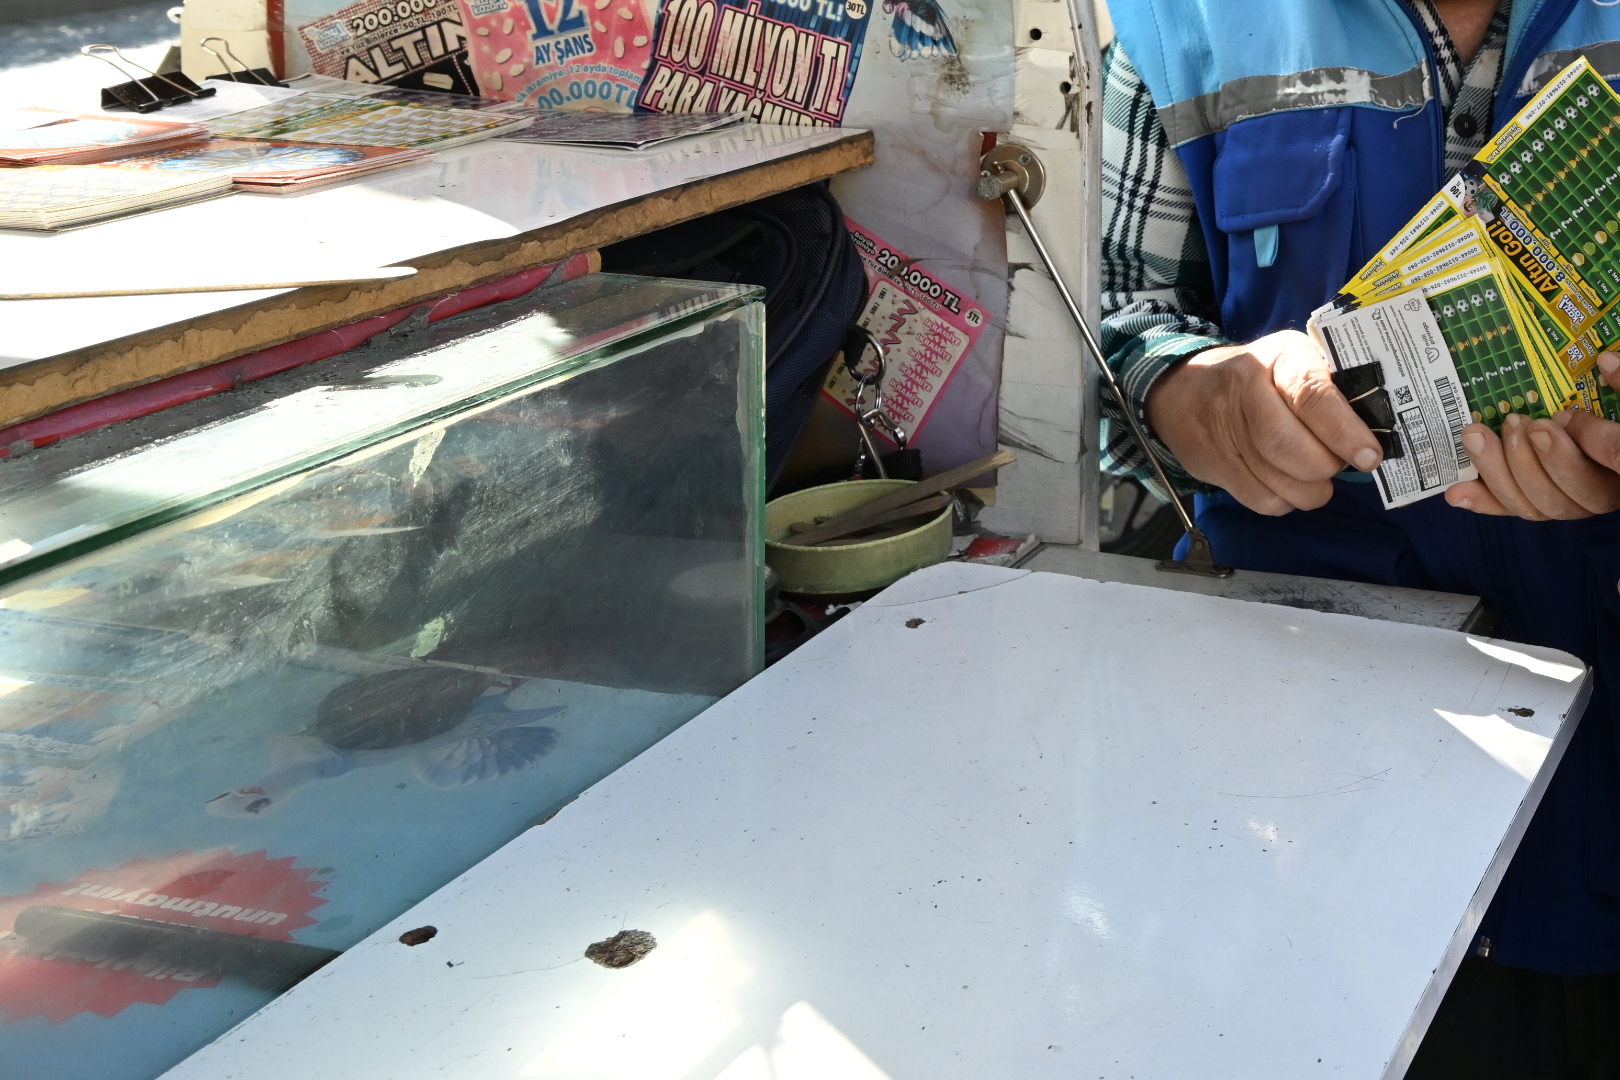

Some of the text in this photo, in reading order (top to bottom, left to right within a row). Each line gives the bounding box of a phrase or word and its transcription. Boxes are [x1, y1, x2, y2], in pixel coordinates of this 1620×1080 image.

[846, 1, 866, 15] 30TL
[367, 27, 397, 43] Binlerce
[403, 21, 413, 29] 50
[432, 9, 445, 17] 100
[535, 34, 594, 66] AY ŞANS
[710, 3, 816, 104] MİLYON
[815, 36, 848, 117] TL
[569, 65, 581, 74] 12
[583, 64, 607, 75] ayda
[609, 66, 643, 85] toplam
[643, 65, 714, 112] PARA
[1451, 186, 1461, 197] 100
[1499, 207, 1566, 282] 8.000.000 TL
[867, 259, 878, 268] Yüz
[1486, 219, 1558, 296] Altın Gol!
[1600, 283, 1609, 292] Maç
[1612, 272, 1620, 281] Maç
[940, 292, 964, 314] TL
[1560, 295, 1584, 320] kazan!
[1582, 300, 1595, 315] Büyük
[967, 311, 980, 323] 5TL
[925, 319, 960, 346] İKRAMİYE
[1423, 322, 1434, 343] piyango
[1551, 331, 1559, 340] Maç
[1602, 325, 1611, 335] Maç
[916, 334, 951, 361] İKRAMİYE
[909, 348, 942, 376] İKRAMİYE
[900, 364, 932, 391] İKRAMİYE
[890, 379, 923, 407] İKRAMİYE
[63, 882, 286, 926] unutmayın!
